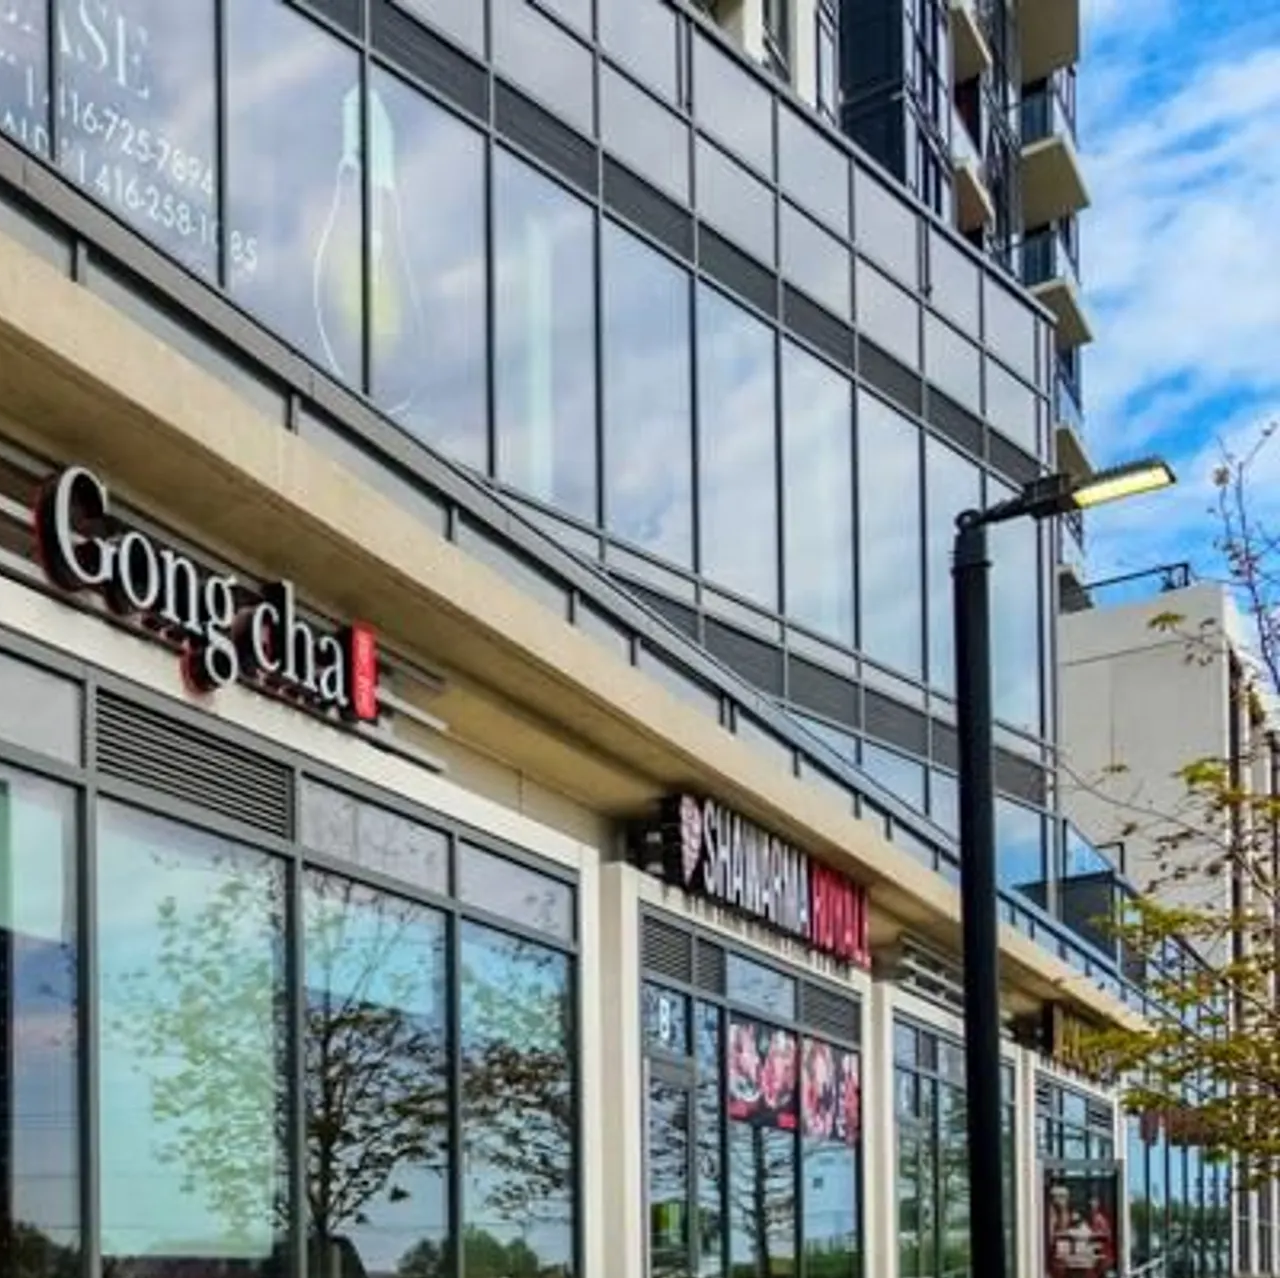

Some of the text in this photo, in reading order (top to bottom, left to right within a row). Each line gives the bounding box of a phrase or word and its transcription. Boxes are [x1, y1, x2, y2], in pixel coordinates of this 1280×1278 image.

[54, 465, 237, 687] Gong
[251, 579, 350, 707] cha
[703, 799, 811, 939] SHAWARMA
